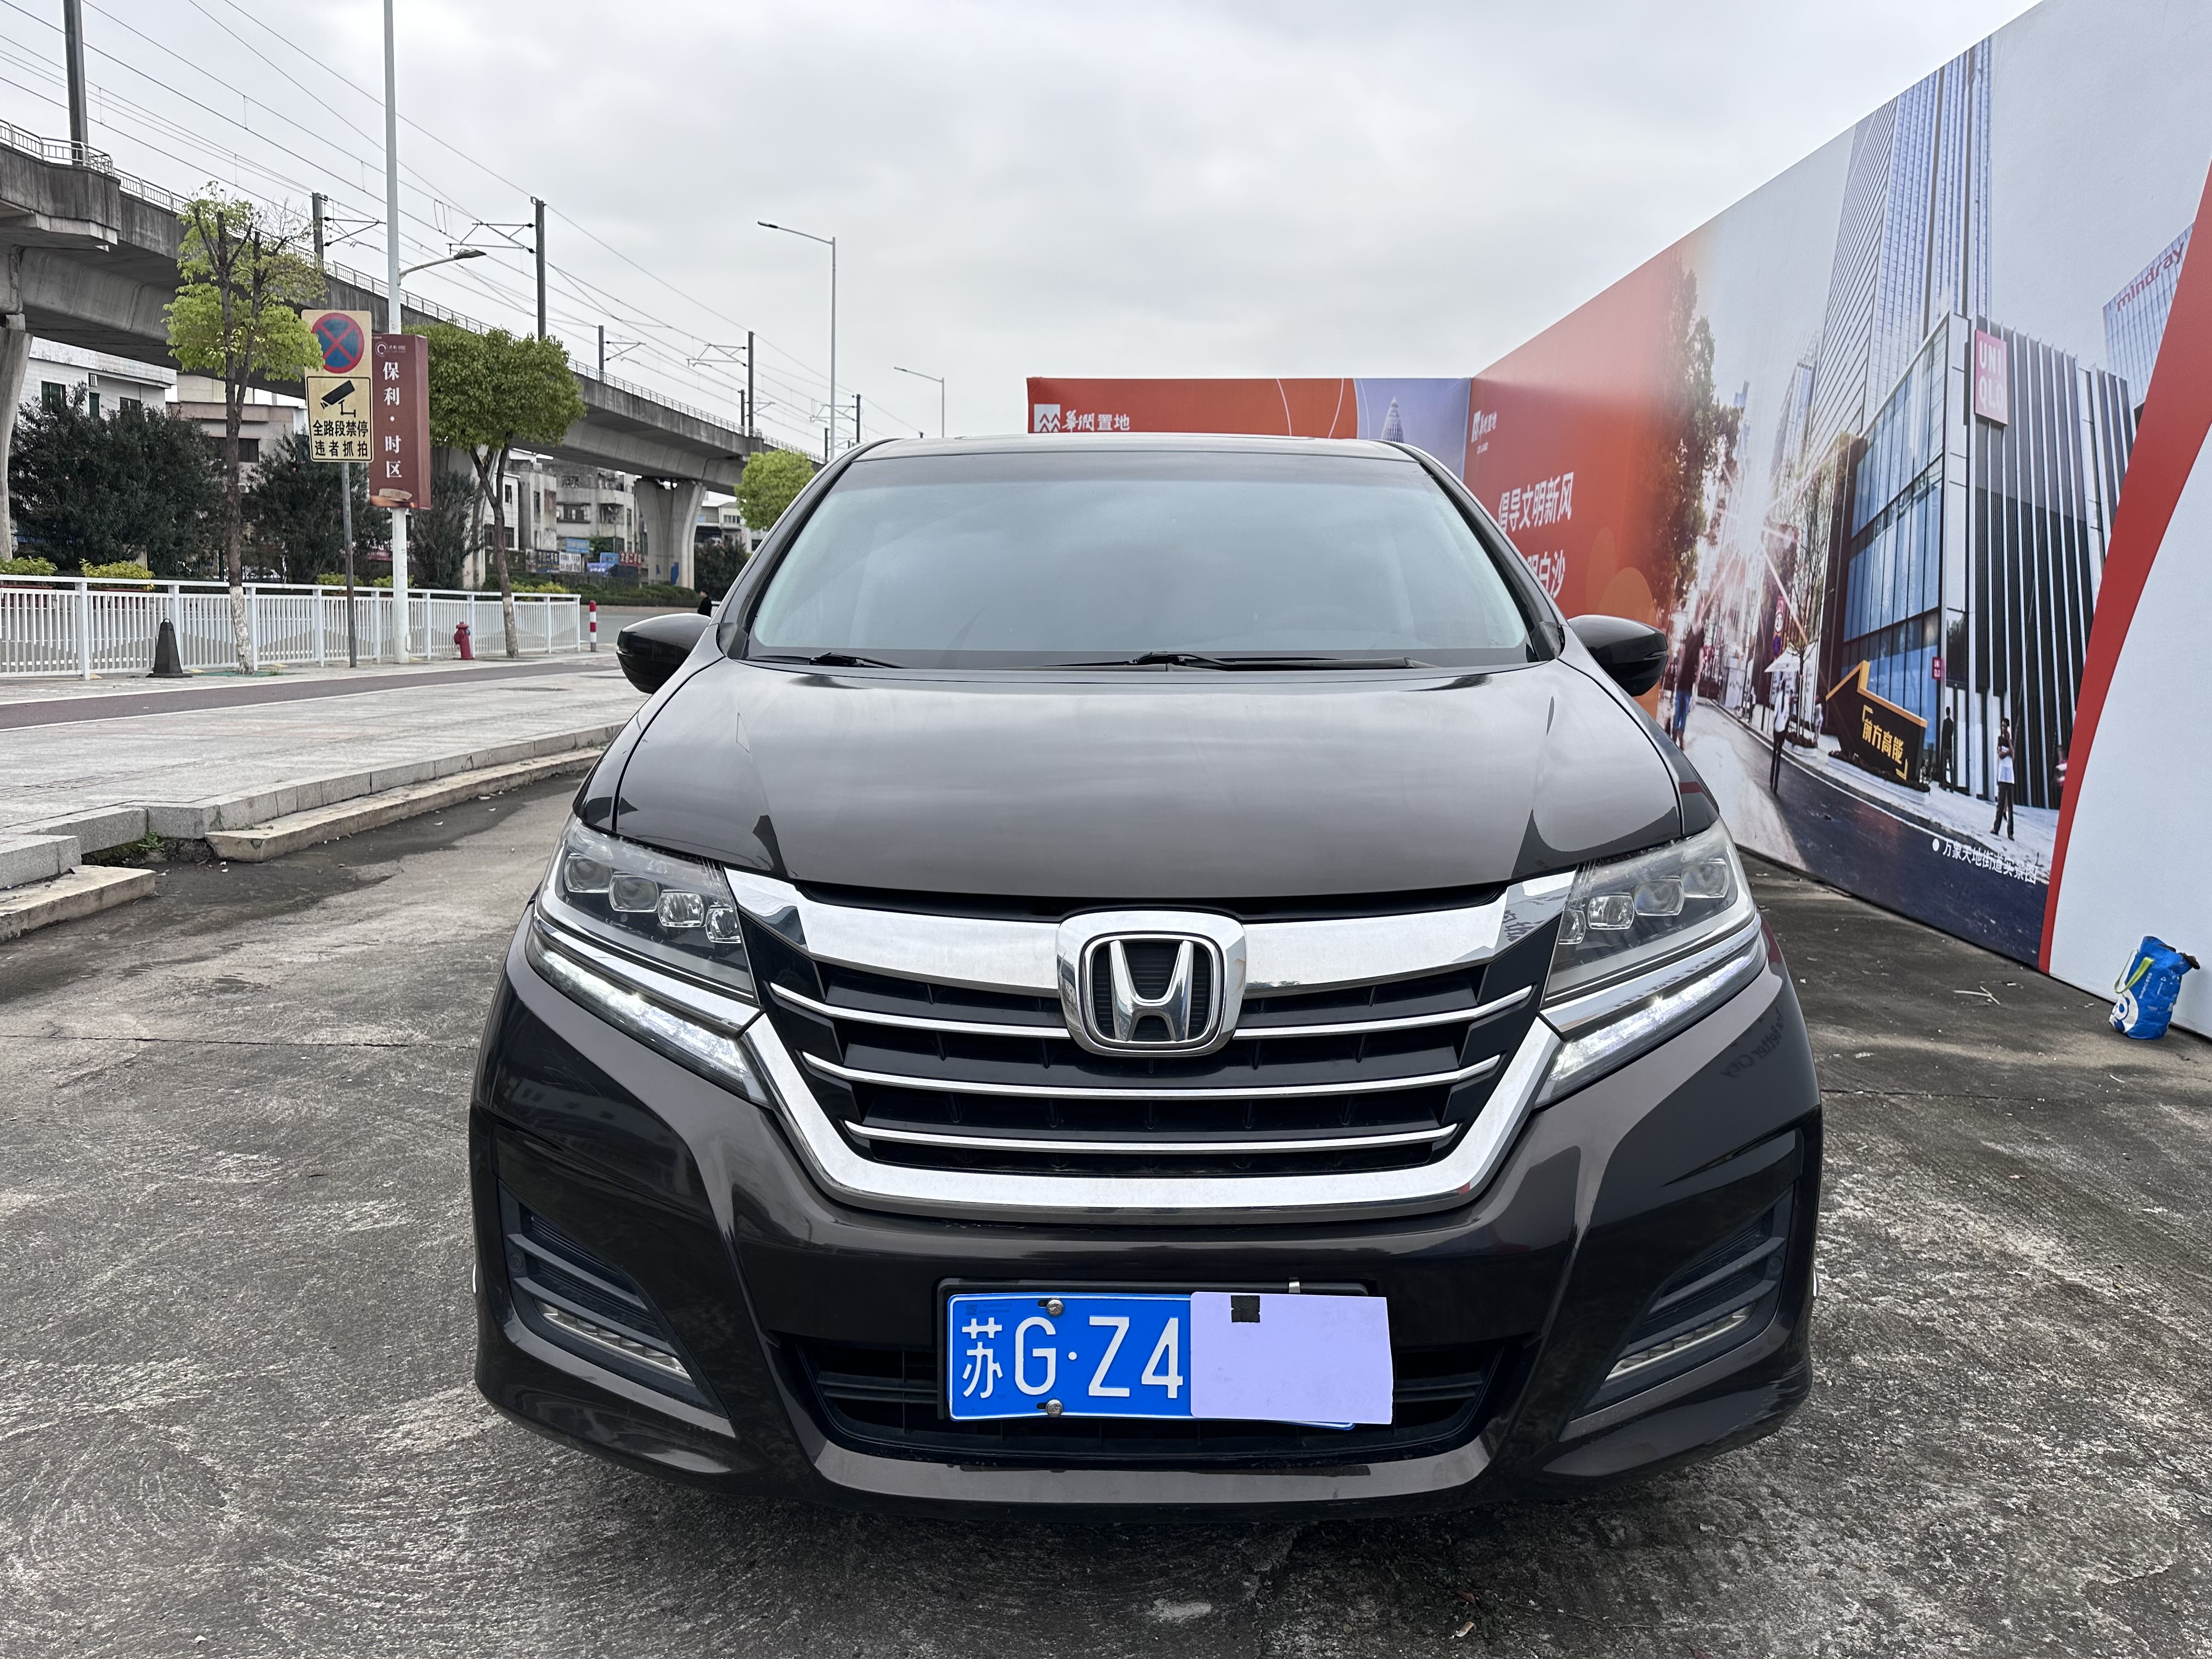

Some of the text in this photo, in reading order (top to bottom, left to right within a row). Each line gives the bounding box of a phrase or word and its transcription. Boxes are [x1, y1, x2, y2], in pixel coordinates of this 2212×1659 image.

[2117, 241, 2184, 312] mindray
[1979, 340, 2002, 376] UNI
[1979, 375, 2004, 411] QLO
[313, 420, 368, 437] 全路段禁停
[383, 362, 403, 478] 保利·时区
[315, 440, 368, 457] 违者抓拍
[1498, 471, 1574, 534] 倡导文明新风
